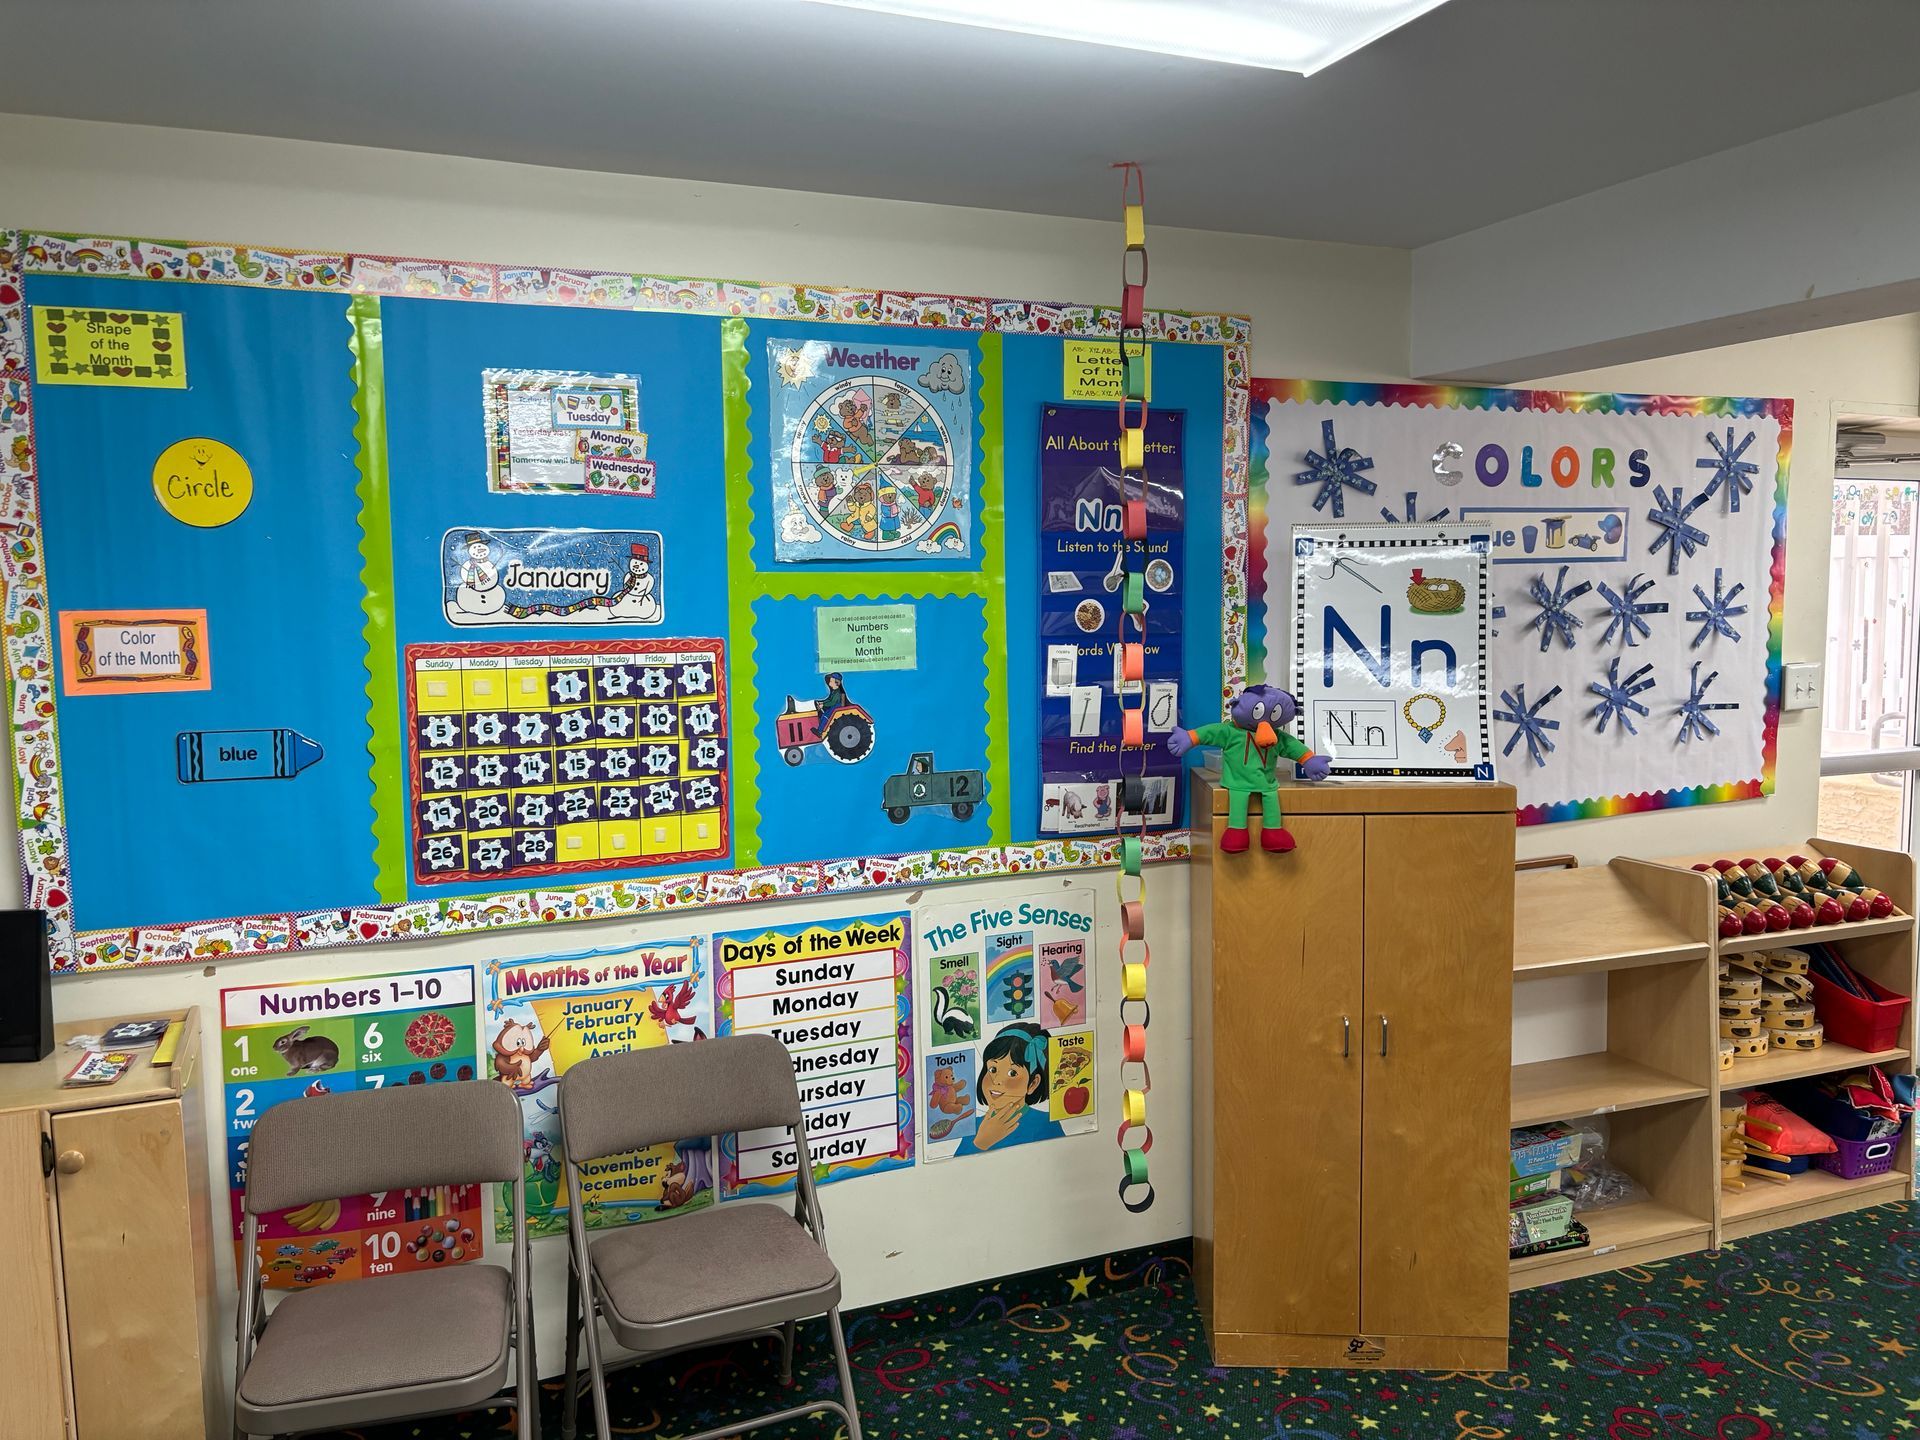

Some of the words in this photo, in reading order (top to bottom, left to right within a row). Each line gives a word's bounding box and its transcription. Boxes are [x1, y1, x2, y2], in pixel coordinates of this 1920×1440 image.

[43, 239, 66, 251] April
[253, 250, 284, 264] August
[299, 256, 341, 267] September
[402, 264, 440, 273] November
[555, 273, 588, 288] February
[808, 290, 832, 301] August
[956, 301, 985, 314] December
[1034, 305, 1060, 319] February
[86, 322, 131, 336] Shape
[90, 339, 104, 350] of
[108, 339, 130, 350] the
[90, 353, 133, 366] Month
[824, 347, 920, 371] Weather
[1077, 355, 1122, 365] Lette
[1239, 350, 1248, 380] September
[1082, 367, 1100, 375] of
[1106, 368, 1122, 376] th
[834, 381, 852, 391] windy
[1080, 378, 1123, 387] Mon
[567, 412, 611, 424] Tuesday
[590, 430, 634, 447] Monday
[1045, 435, 1064, 450] All
[1068, 436, 1109, 451] About
[1144, 440, 1176, 454] etter:
[592, 460, 651, 476] Wednesday
[1431, 441, 1651, 489] COLORS
[167, 469, 234, 499] Circle
[1075, 498, 1123, 533] Nn
[1492, 529, 1516, 548] ue
[1057, 539, 1094, 553] Listen
[1097, 542, 1109, 552] to
[1298, 540, 1310, 552] N
[0, 535, 17, 577] September
[506, 563, 610, 596] January
[7, 588, 19, 620] August
[847, 622, 889, 633] Numbers
[120, 630, 155, 645] Color
[856, 635, 865, 644] of
[867, 635, 882, 644] the
[855, 647, 884, 657] Month
[1077, 643, 1103, 656] ords
[98, 651, 112, 667] of
[114, 651, 136, 667] the
[140, 651, 181, 667] Month
[469, 659, 499, 667] Monday
[513, 658, 544, 666] Tuesday
[551, 656, 592, 665] Wednesday
[598, 656, 630, 664] Thursday
[680, 653, 712, 661] Saturday
[425, 660, 454, 668] Sunday
[611, 675, 621, 687] 2
[651, 676, 660, 688] 3
[690, 673, 699, 684] 4
[566, 680, 571, 692] 1
[17, 693, 28, 714] June
[569, 720, 579, 731] 8
[610, 716, 619, 727] 9
[652, 714, 667, 724] 10
[696, 713, 708, 725] 11
[436, 725, 446, 737] 5
[483, 722, 493, 734] 6
[526, 723, 536, 735] 7
[700, 747, 715, 758] 18
[1070, 741, 1094, 754] Find
[1098, 741, 1116, 752] the
[219, 747, 258, 762] blue
[652, 754, 667, 766] 17
[524, 762, 540, 774] 14
[570, 759, 585, 770] 15
[611, 758, 626, 769] 16
[436, 767, 453, 779] 12
[481, 765, 497, 776] 13
[1477, 765, 1489, 777] N
[950, 775, 970, 797] 12
[653, 790, 671, 803] 24
[694, 787, 712, 799] 25
[566, 798, 586, 811] 22
[611, 796, 629, 808] 23
[433, 807, 450, 821] 19
[479, 805, 499, 818] 20
[527, 804, 543, 815] 21
[25, 838, 39, 864] March
[525, 840, 546, 852] 28
[432, 848, 452, 860] 26
[482, 848, 500, 860] 27
[827, 860, 853, 872] January
[869, 859, 897, 870] February
[747, 868, 778, 881] November
[786, 869, 817, 878] December
[663, 877, 698, 891] September
[712, 876, 739, 886] October
[405, 904, 430, 916] March
[300, 912, 333, 926] January
[356, 911, 392, 923] February
[191, 921, 233, 937] November
[246, 922, 287, 933] December
[923, 923, 967, 952] The
[969, 908, 1013, 934] Five
[1018, 903, 1093, 933] Senses
[80, 932, 126, 949] September
[145, 932, 182, 943] October
[723, 942, 776, 963] Days
[783, 936, 803, 956] of
[810, 933, 842, 951] the
[846, 925, 901, 947] Week
[996, 935, 1024, 949] Sight
[1041, 942, 1083, 957] Hearing
[939, 958, 970, 970] Smell
[505, 965, 589, 996] Months
[594, 966, 609, 984] of
[613, 961, 639, 980] the
[641, 952, 687, 978] Year
[775, 961, 855, 987] Sunday
[259, 986, 382, 1016] Numbers
[390, 978, 442, 1003] 1-10
[772, 989, 859, 1016] Monday
[562, 998, 634, 1016] January
[566, 1011, 644, 1031] February
[363, 1023, 384, 1049] 6
[582, 1030, 637, 1046] March
[1057, 1036, 1085, 1048] Taste
[233, 1036, 250, 1063] 1
[361, 1051, 382, 1063] six
[793, 1046, 880, 1074] dnesday
[934, 1053, 966, 1067] Touch
[230, 1064, 258, 1077] one
[799, 1079, 866, 1104] ursday
[235, 1089, 256, 1116] 2
[772, 1135, 868, 1169] Saurday
[366, 1207, 396, 1221] nine
[365, 1232, 401, 1260] 10
[369, 1261, 393, 1274] ten
